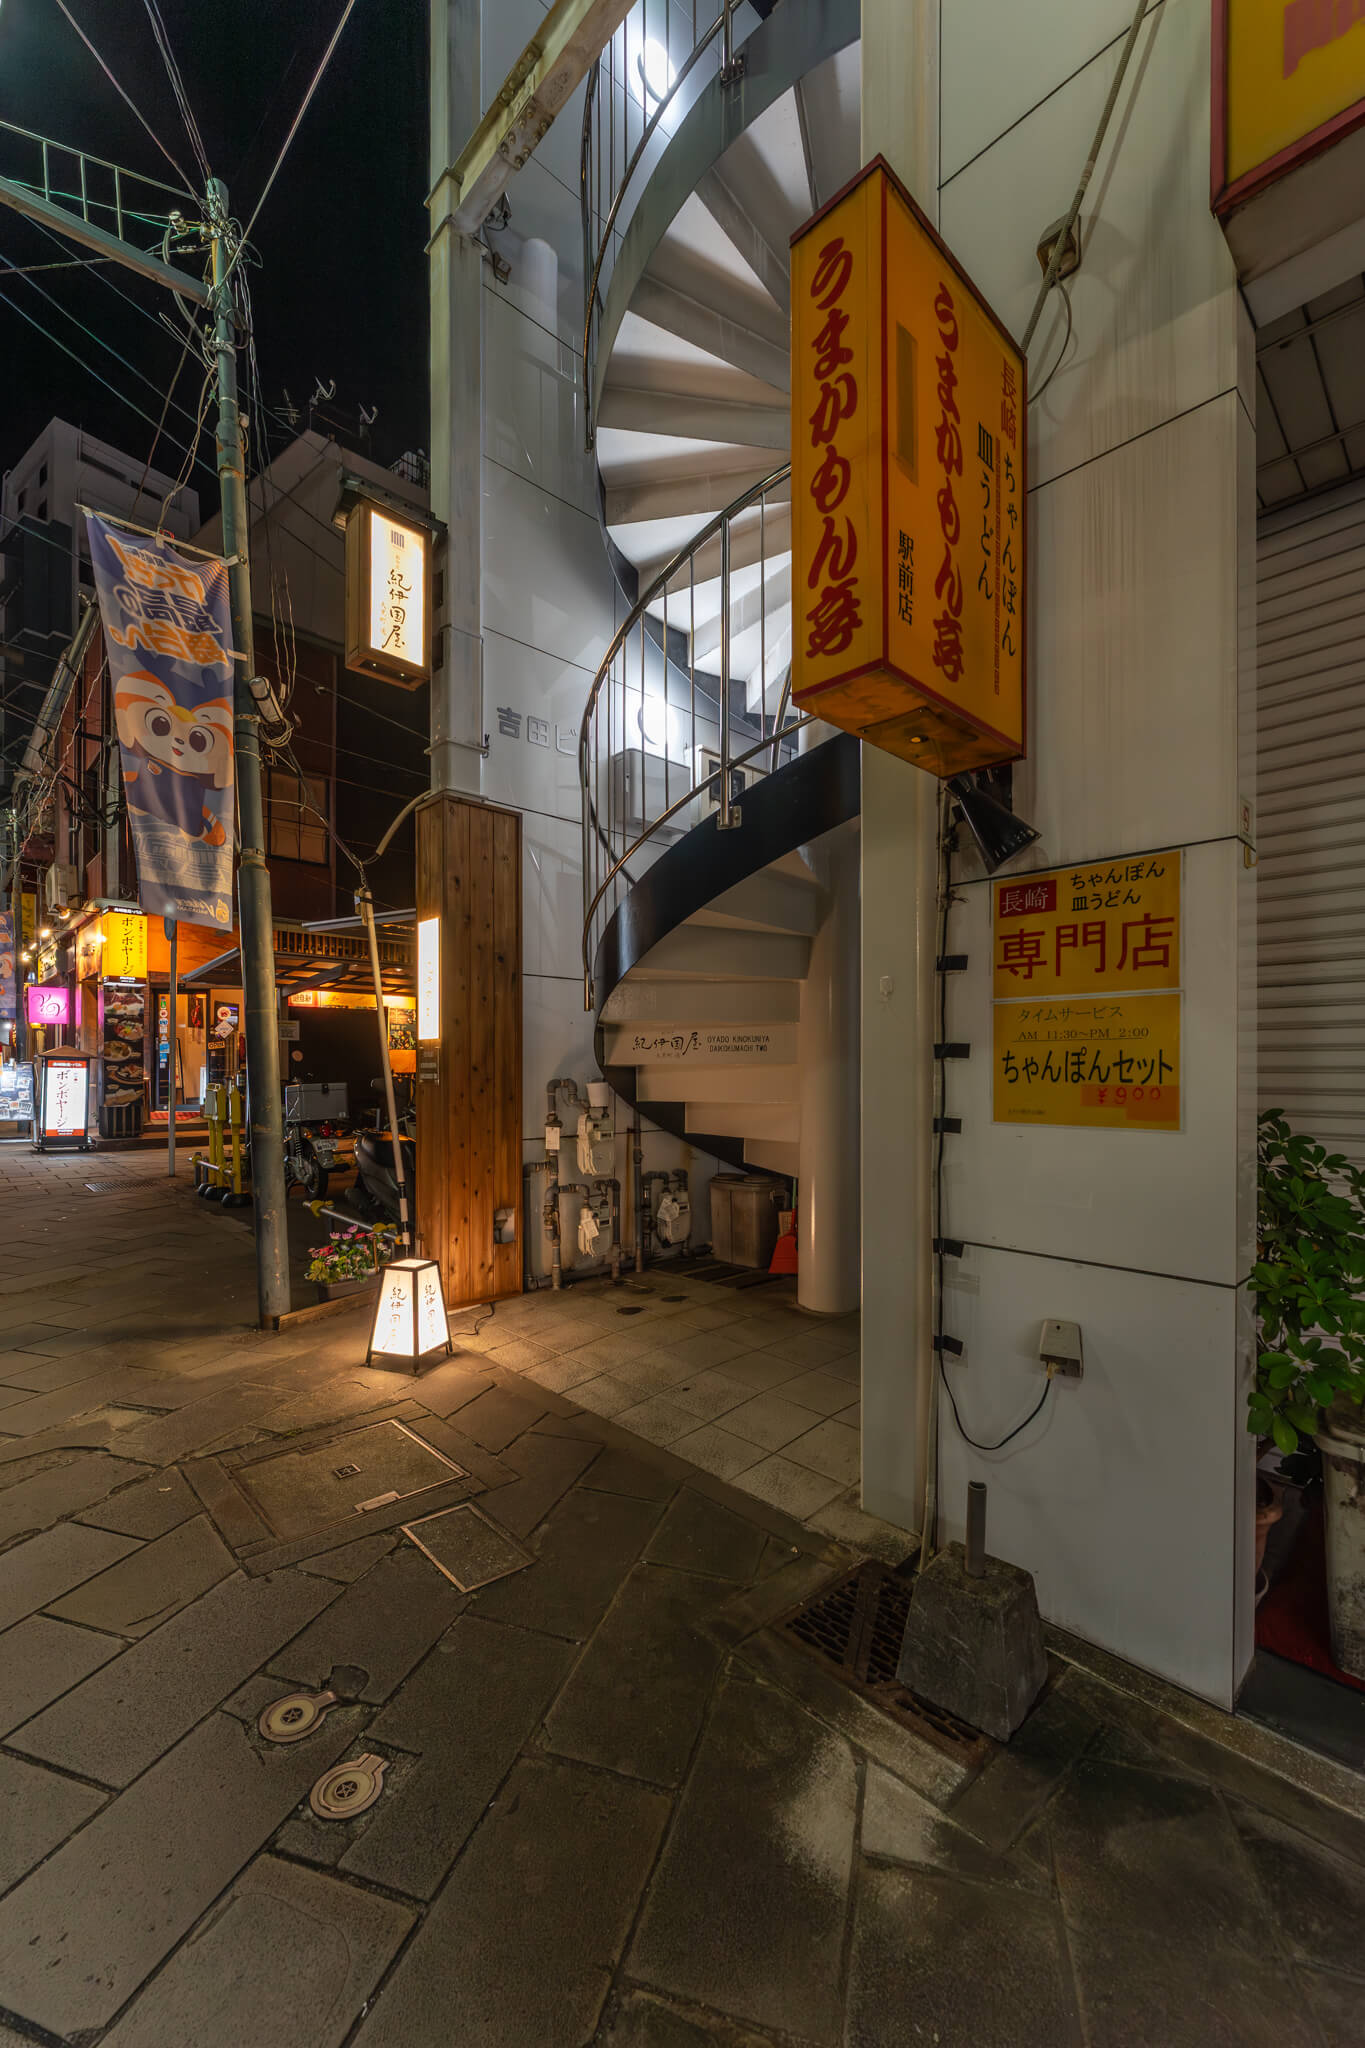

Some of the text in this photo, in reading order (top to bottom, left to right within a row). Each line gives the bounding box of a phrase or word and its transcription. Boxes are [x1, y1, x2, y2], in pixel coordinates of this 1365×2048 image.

[977, 421, 993, 601] 皿うどん
[898, 528, 914, 627] 駅前店
[1070, 861, 1165, 890] ちゃんぽん
[1001, 887, 1049, 915] 長崎
[1071, 888, 1142, 912] 皿うどん
[997, 913, 1175, 980] 専門店
[1017, 1005, 1123, 1023] タイムサービス
[1018, 1030, 1038, 1040] AM
[1119, 1027, 1149, 1038] 2:00
[1001, 1046, 1173, 1084] ちゃんぽんセット
